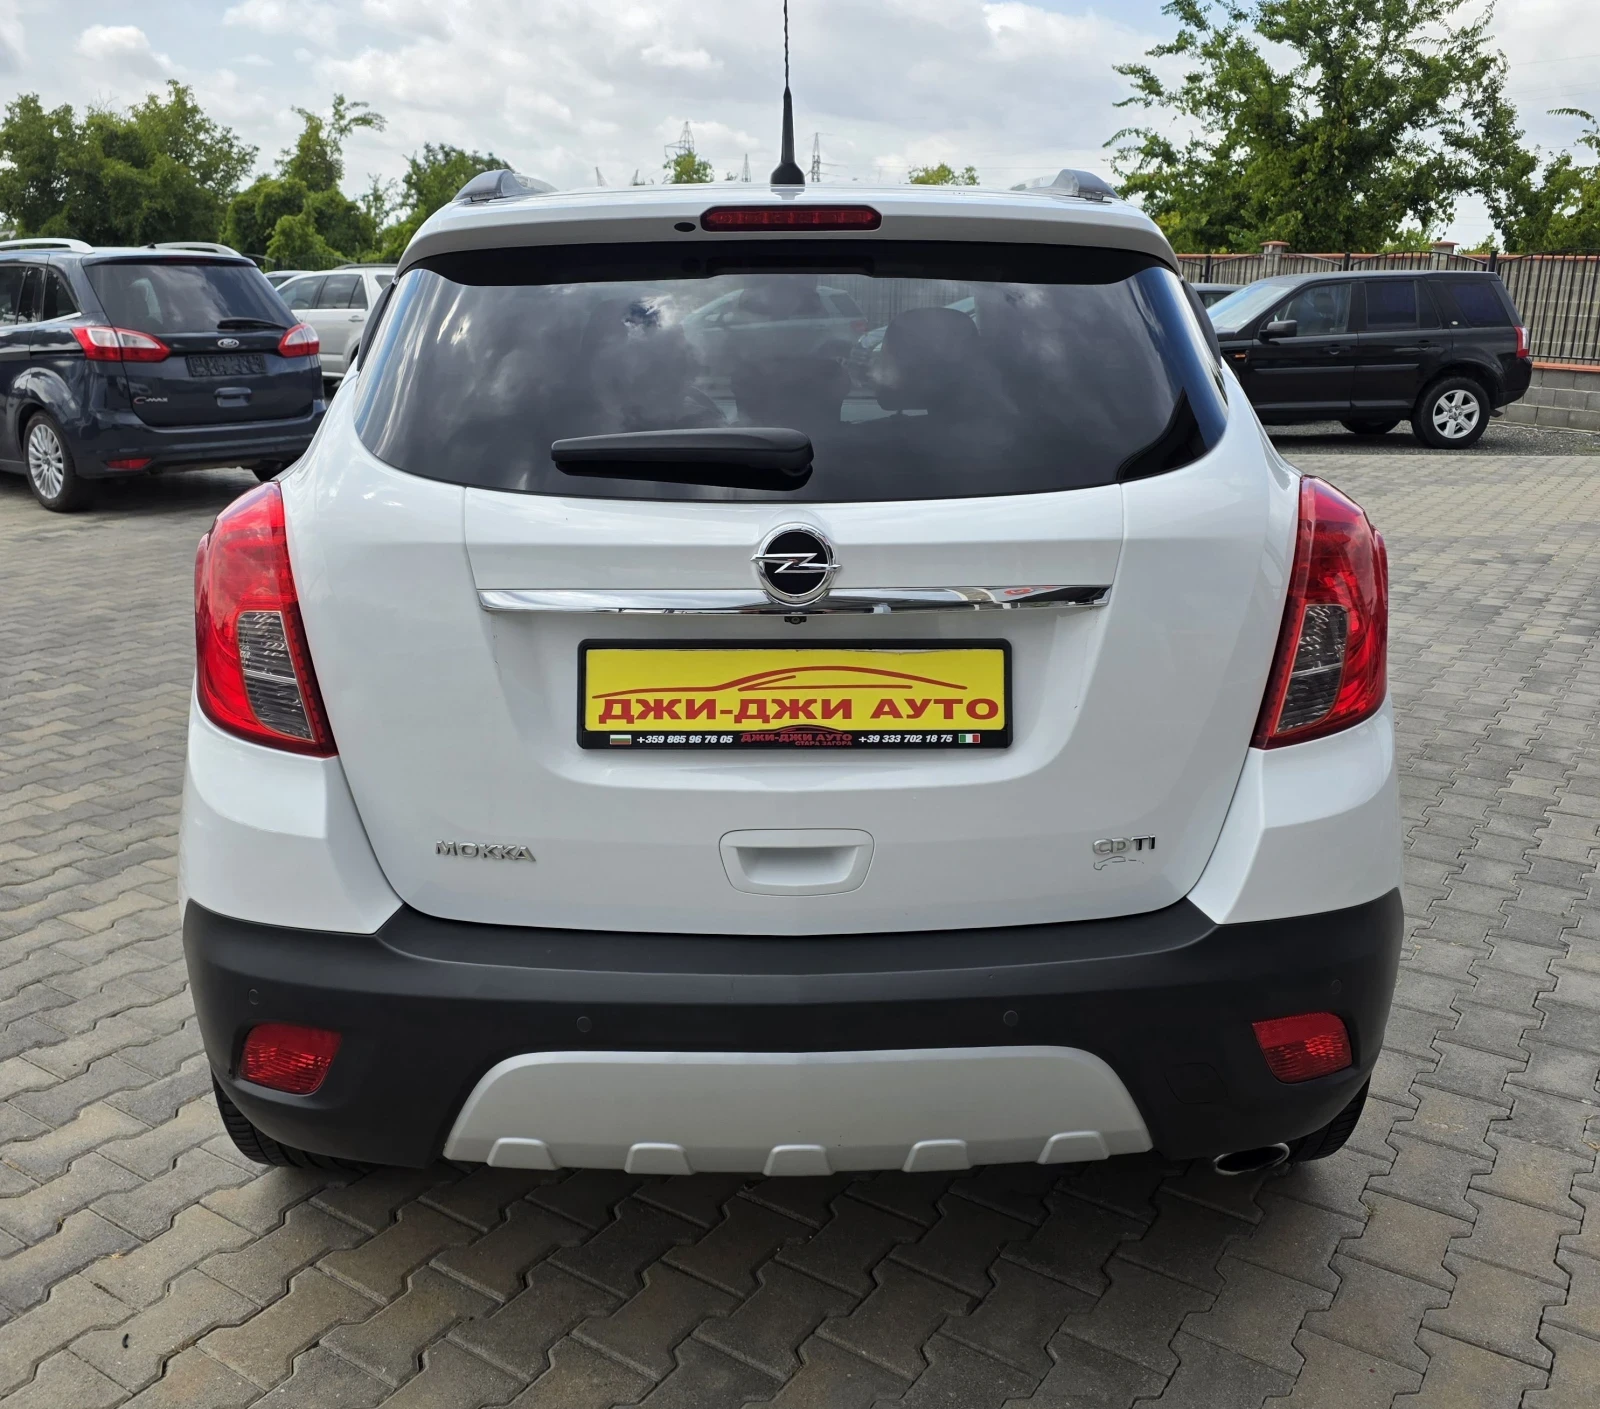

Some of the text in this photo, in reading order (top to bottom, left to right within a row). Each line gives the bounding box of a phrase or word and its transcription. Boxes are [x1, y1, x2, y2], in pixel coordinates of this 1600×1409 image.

[598, 698, 999, 724] ДЖИ-ДЖИ АУТО
[637, 735, 665, 744] +359
[704, 735, 718, 744] 76
[720, 735, 733, 744] 05
[741, 733, 852, 742] ДЖИ-ДЖИ АУТО
[858, 734, 953, 743] +39 333 702 18 75
[435, 840, 536, 862] MOKKA
[1092, 834, 1156, 855] CDTI
